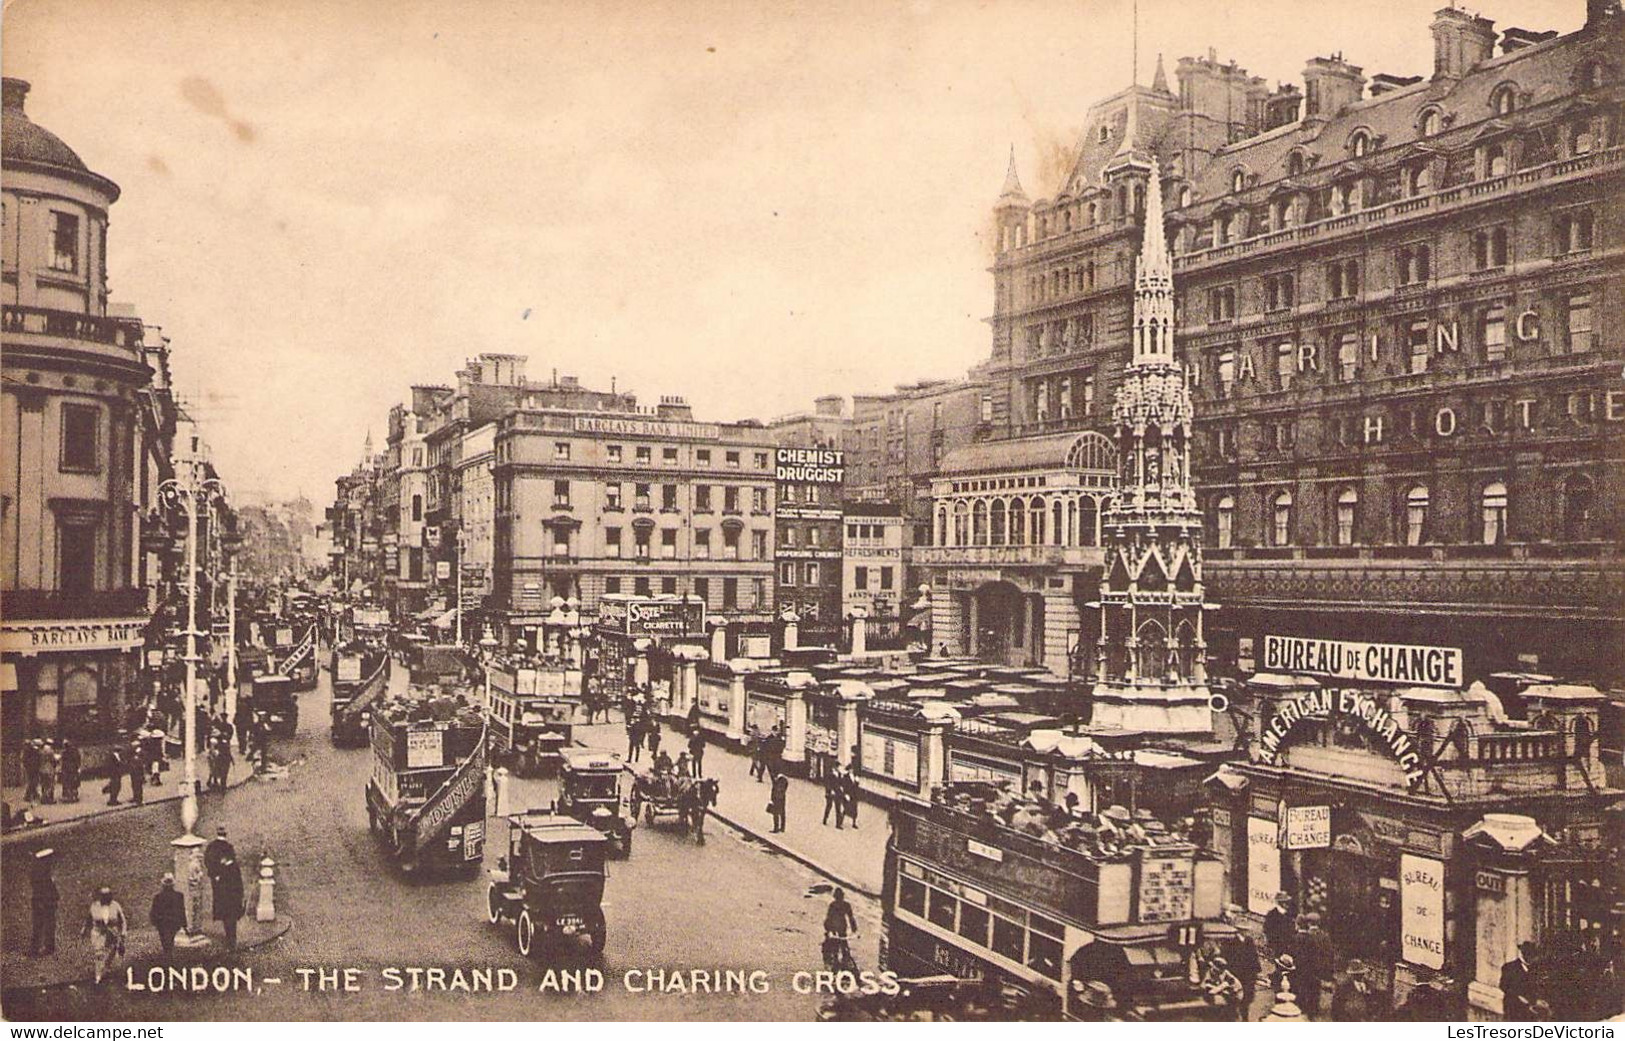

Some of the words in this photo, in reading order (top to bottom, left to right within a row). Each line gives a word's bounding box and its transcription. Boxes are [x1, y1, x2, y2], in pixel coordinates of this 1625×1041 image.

[578, 419, 637, 433] BARCLAYS
[642, 423, 670, 436] BANK
[777, 449, 843, 464] CHEMIST
[776, 467, 844, 482] DRUGGIST
[844, 548, 900, 557] REFRESHMENTS
[32, 630, 97, 645] BARCLAYS
[107, 628, 128, 642] BANK
[1268, 637, 1342, 674] BUREAU
[1347, 650, 1361, 671] DE
[1365, 646, 1457, 684] CHANGE
[1259, 690, 1332, 765] AMERICAN
[1339, 688, 1424, 787] EXCHANGE
[1290, 807, 1330, 823] BUREAU
[1303, 823, 1315, 832] DE
[1289, 831, 1329, 846] CHANGE
[1403, 870, 1442, 893] BUREAU
[1477, 874, 1501, 891] OUT
[1415, 905, 1427, 917] DE
[1404, 933, 1442, 955] CHANGE
